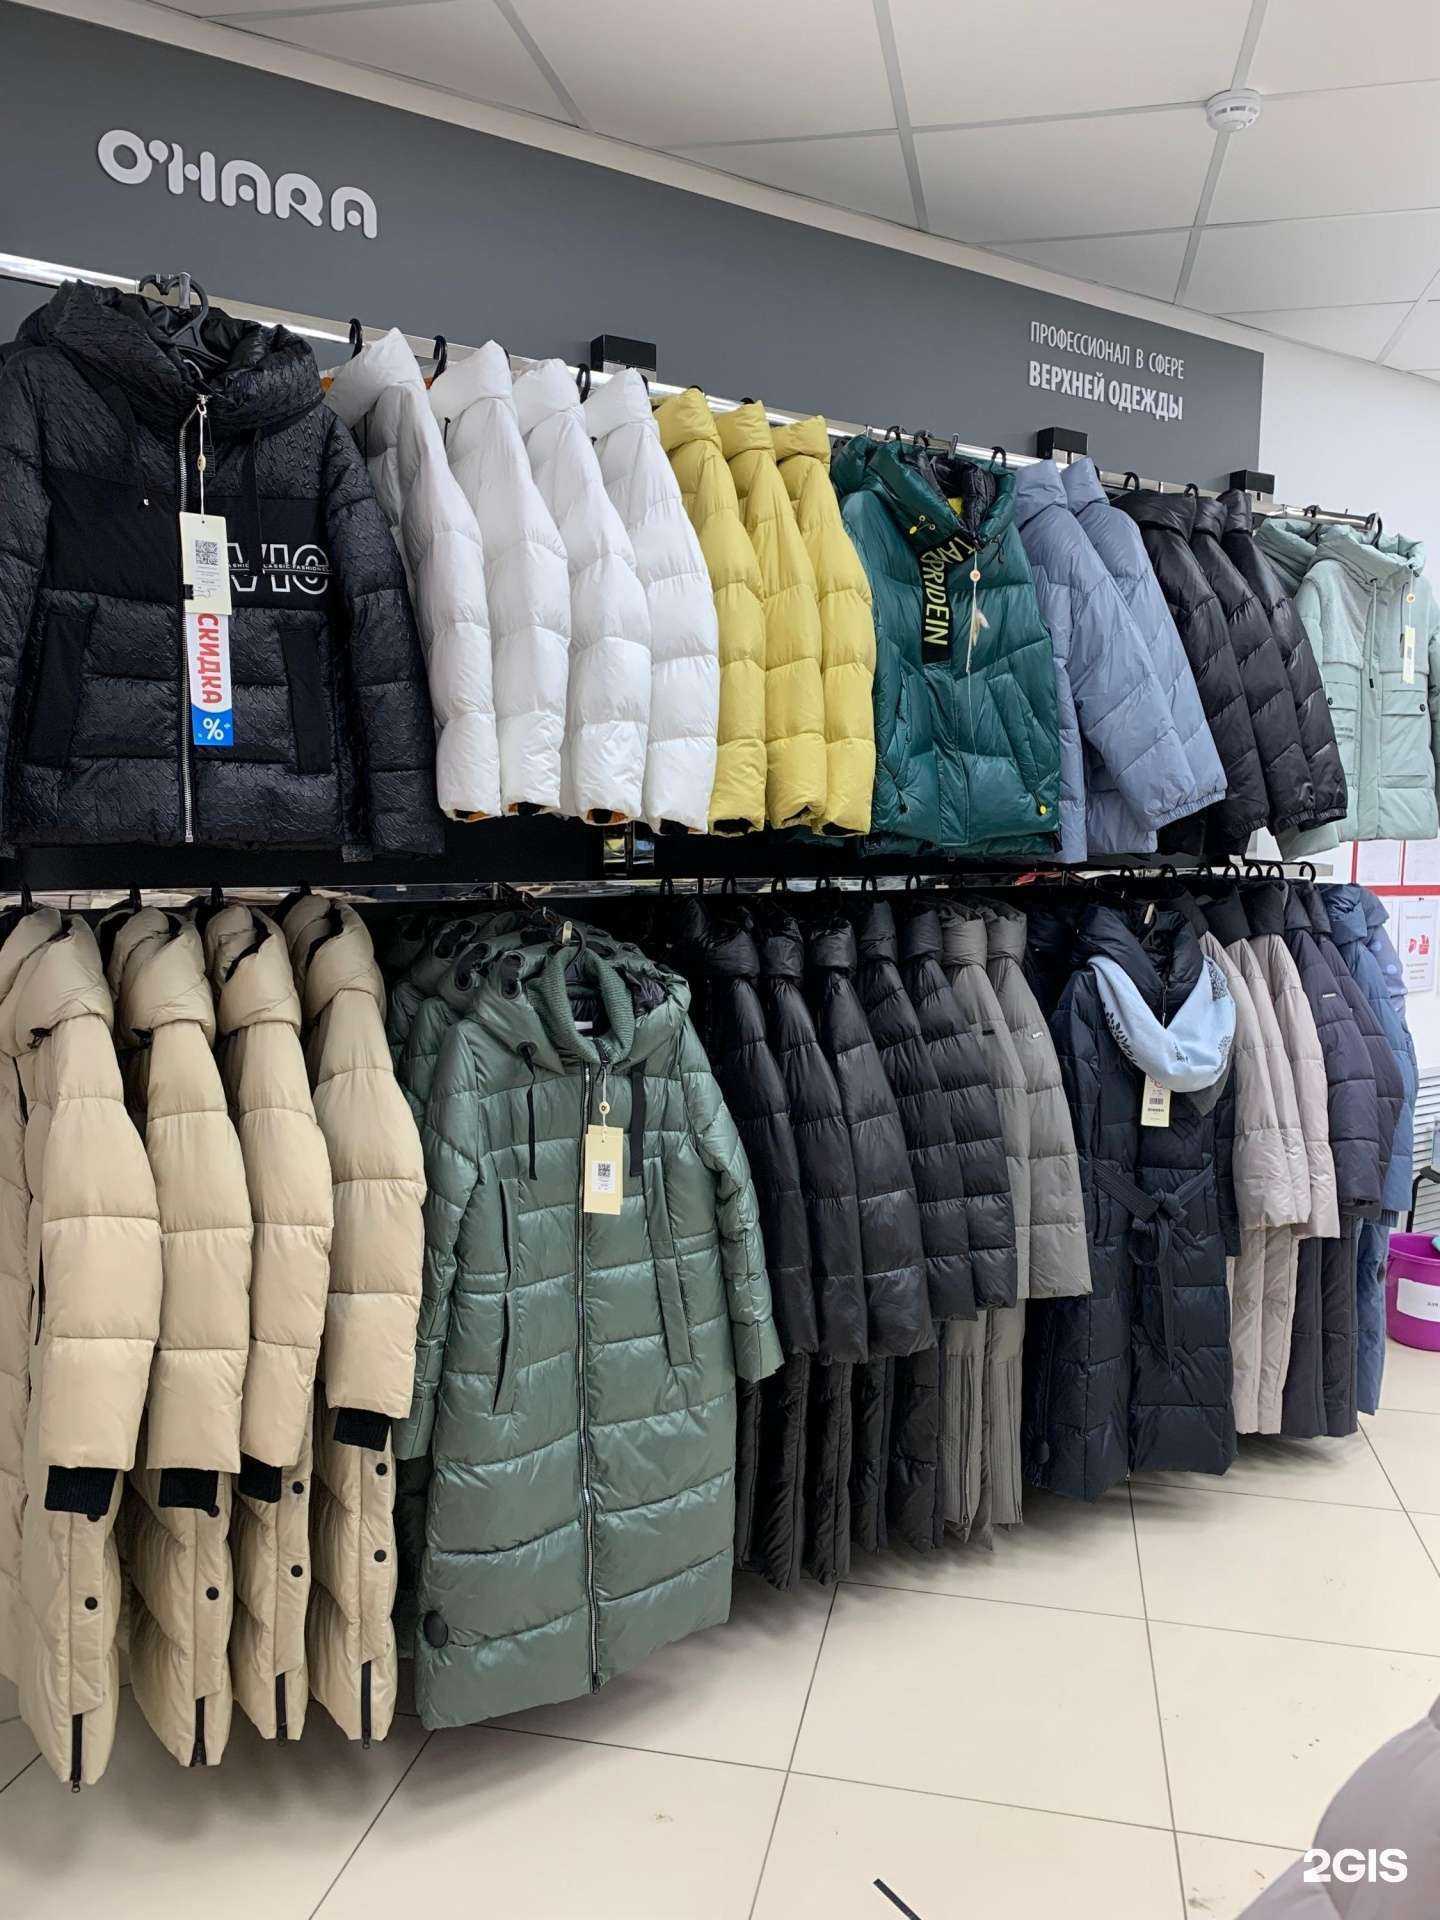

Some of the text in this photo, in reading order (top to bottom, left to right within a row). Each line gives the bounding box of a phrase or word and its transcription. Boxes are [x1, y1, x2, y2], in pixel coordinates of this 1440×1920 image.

[98, 129, 378, 239] O'HARA
[1030, 320, 1185, 380] ПРОФЕССИОНАЛ В СФЕРЕ
[1029, 360, 1183, 422] ВЕРХНЕЙ ОДЕЖДЫ
[197, 613, 223, 704] СКИДКА
